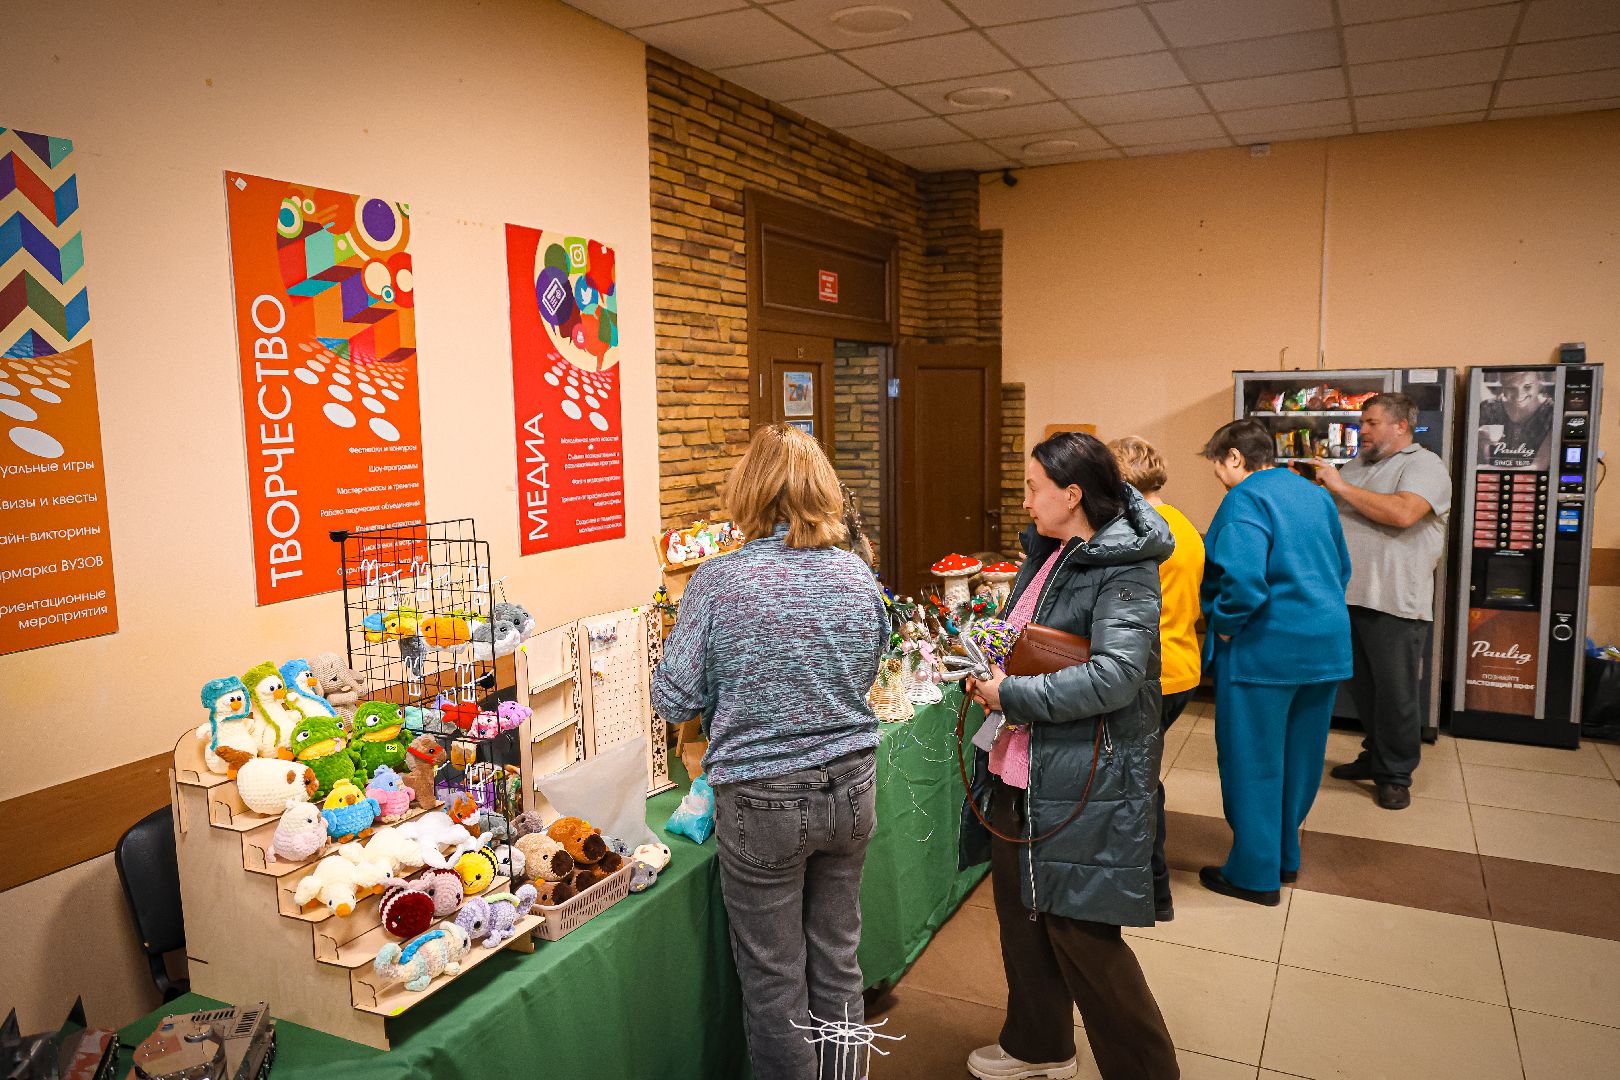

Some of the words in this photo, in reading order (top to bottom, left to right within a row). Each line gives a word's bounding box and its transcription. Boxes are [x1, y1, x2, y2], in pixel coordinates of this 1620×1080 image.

[251, 294, 304, 588] ТВОРЧЕСТВО
[1493, 441, 1535, 457] Paulig
[63, 460, 95, 472] игры
[523, 412, 550, 541] МЕДИА
[0, 499, 36, 510] визы
[40, 497, 49, 507] и
[53, 493, 98, 506] квесты
[61, 555, 104, 572] ВУЗОВ
[19, 605, 108, 630] мероприятия
[1471, 640, 1533, 665] Paulig
